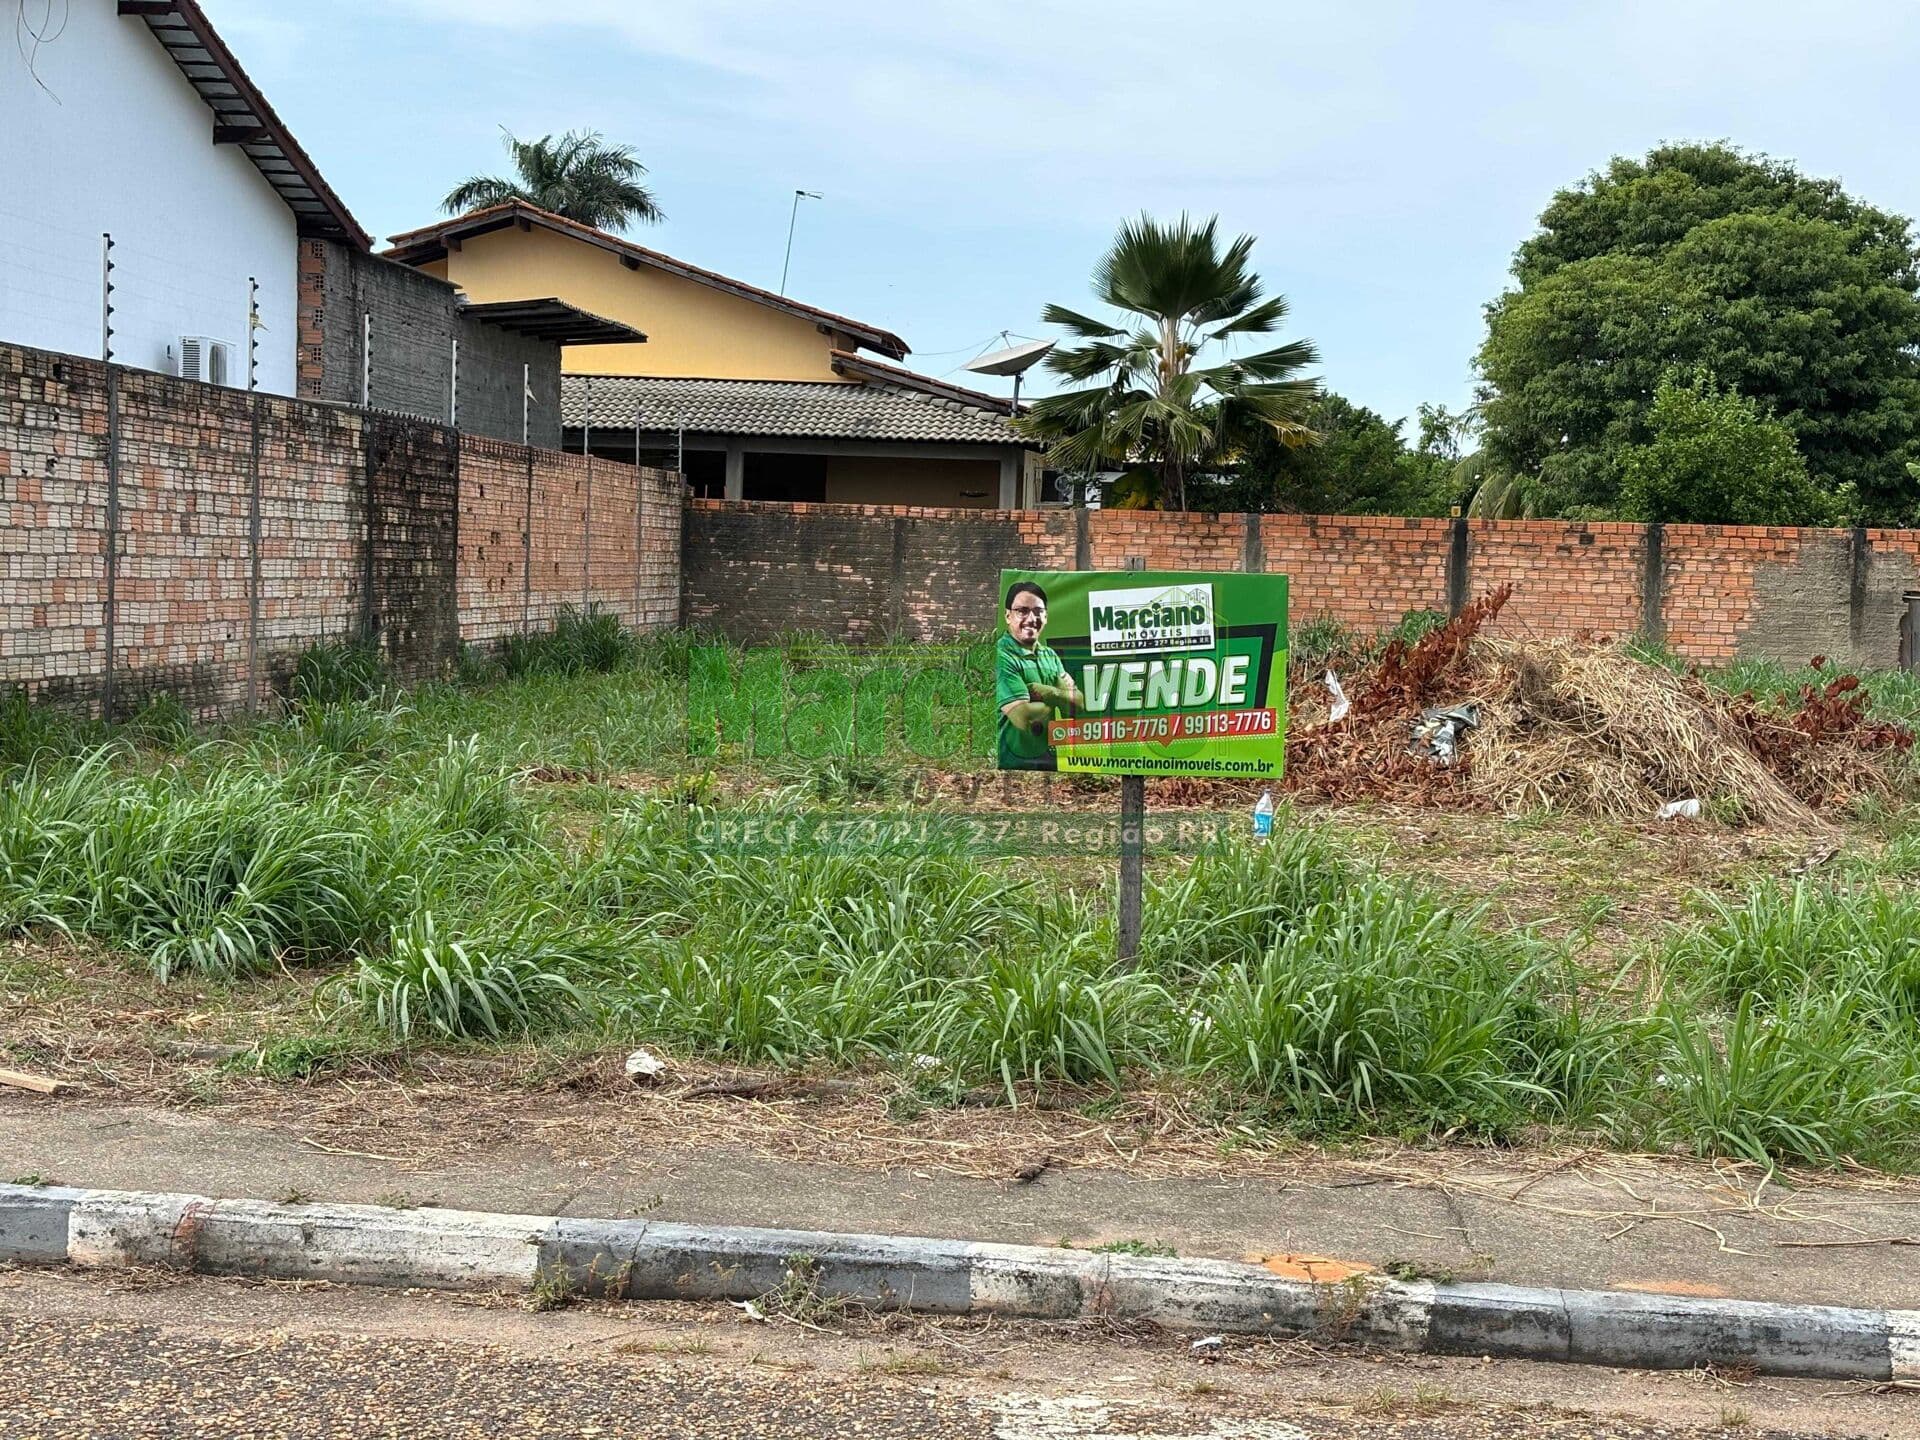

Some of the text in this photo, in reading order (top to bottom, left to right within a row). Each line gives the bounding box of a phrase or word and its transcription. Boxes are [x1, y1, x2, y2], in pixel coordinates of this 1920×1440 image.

[1092, 602, 1206, 631] Marciano
[1095, 642, 1119, 650] CRECI
[1121, 628, 1183, 640] IMÓVEIS
[1082, 655, 1250, 712] VENDE
[1083, 717, 1167, 741] 99116-7776
[1172, 716, 1181, 736] /
[1185, 711, 1271, 735] 99113-7776
[1067, 755, 1274, 774] www.marcianoimoveis.com.br
